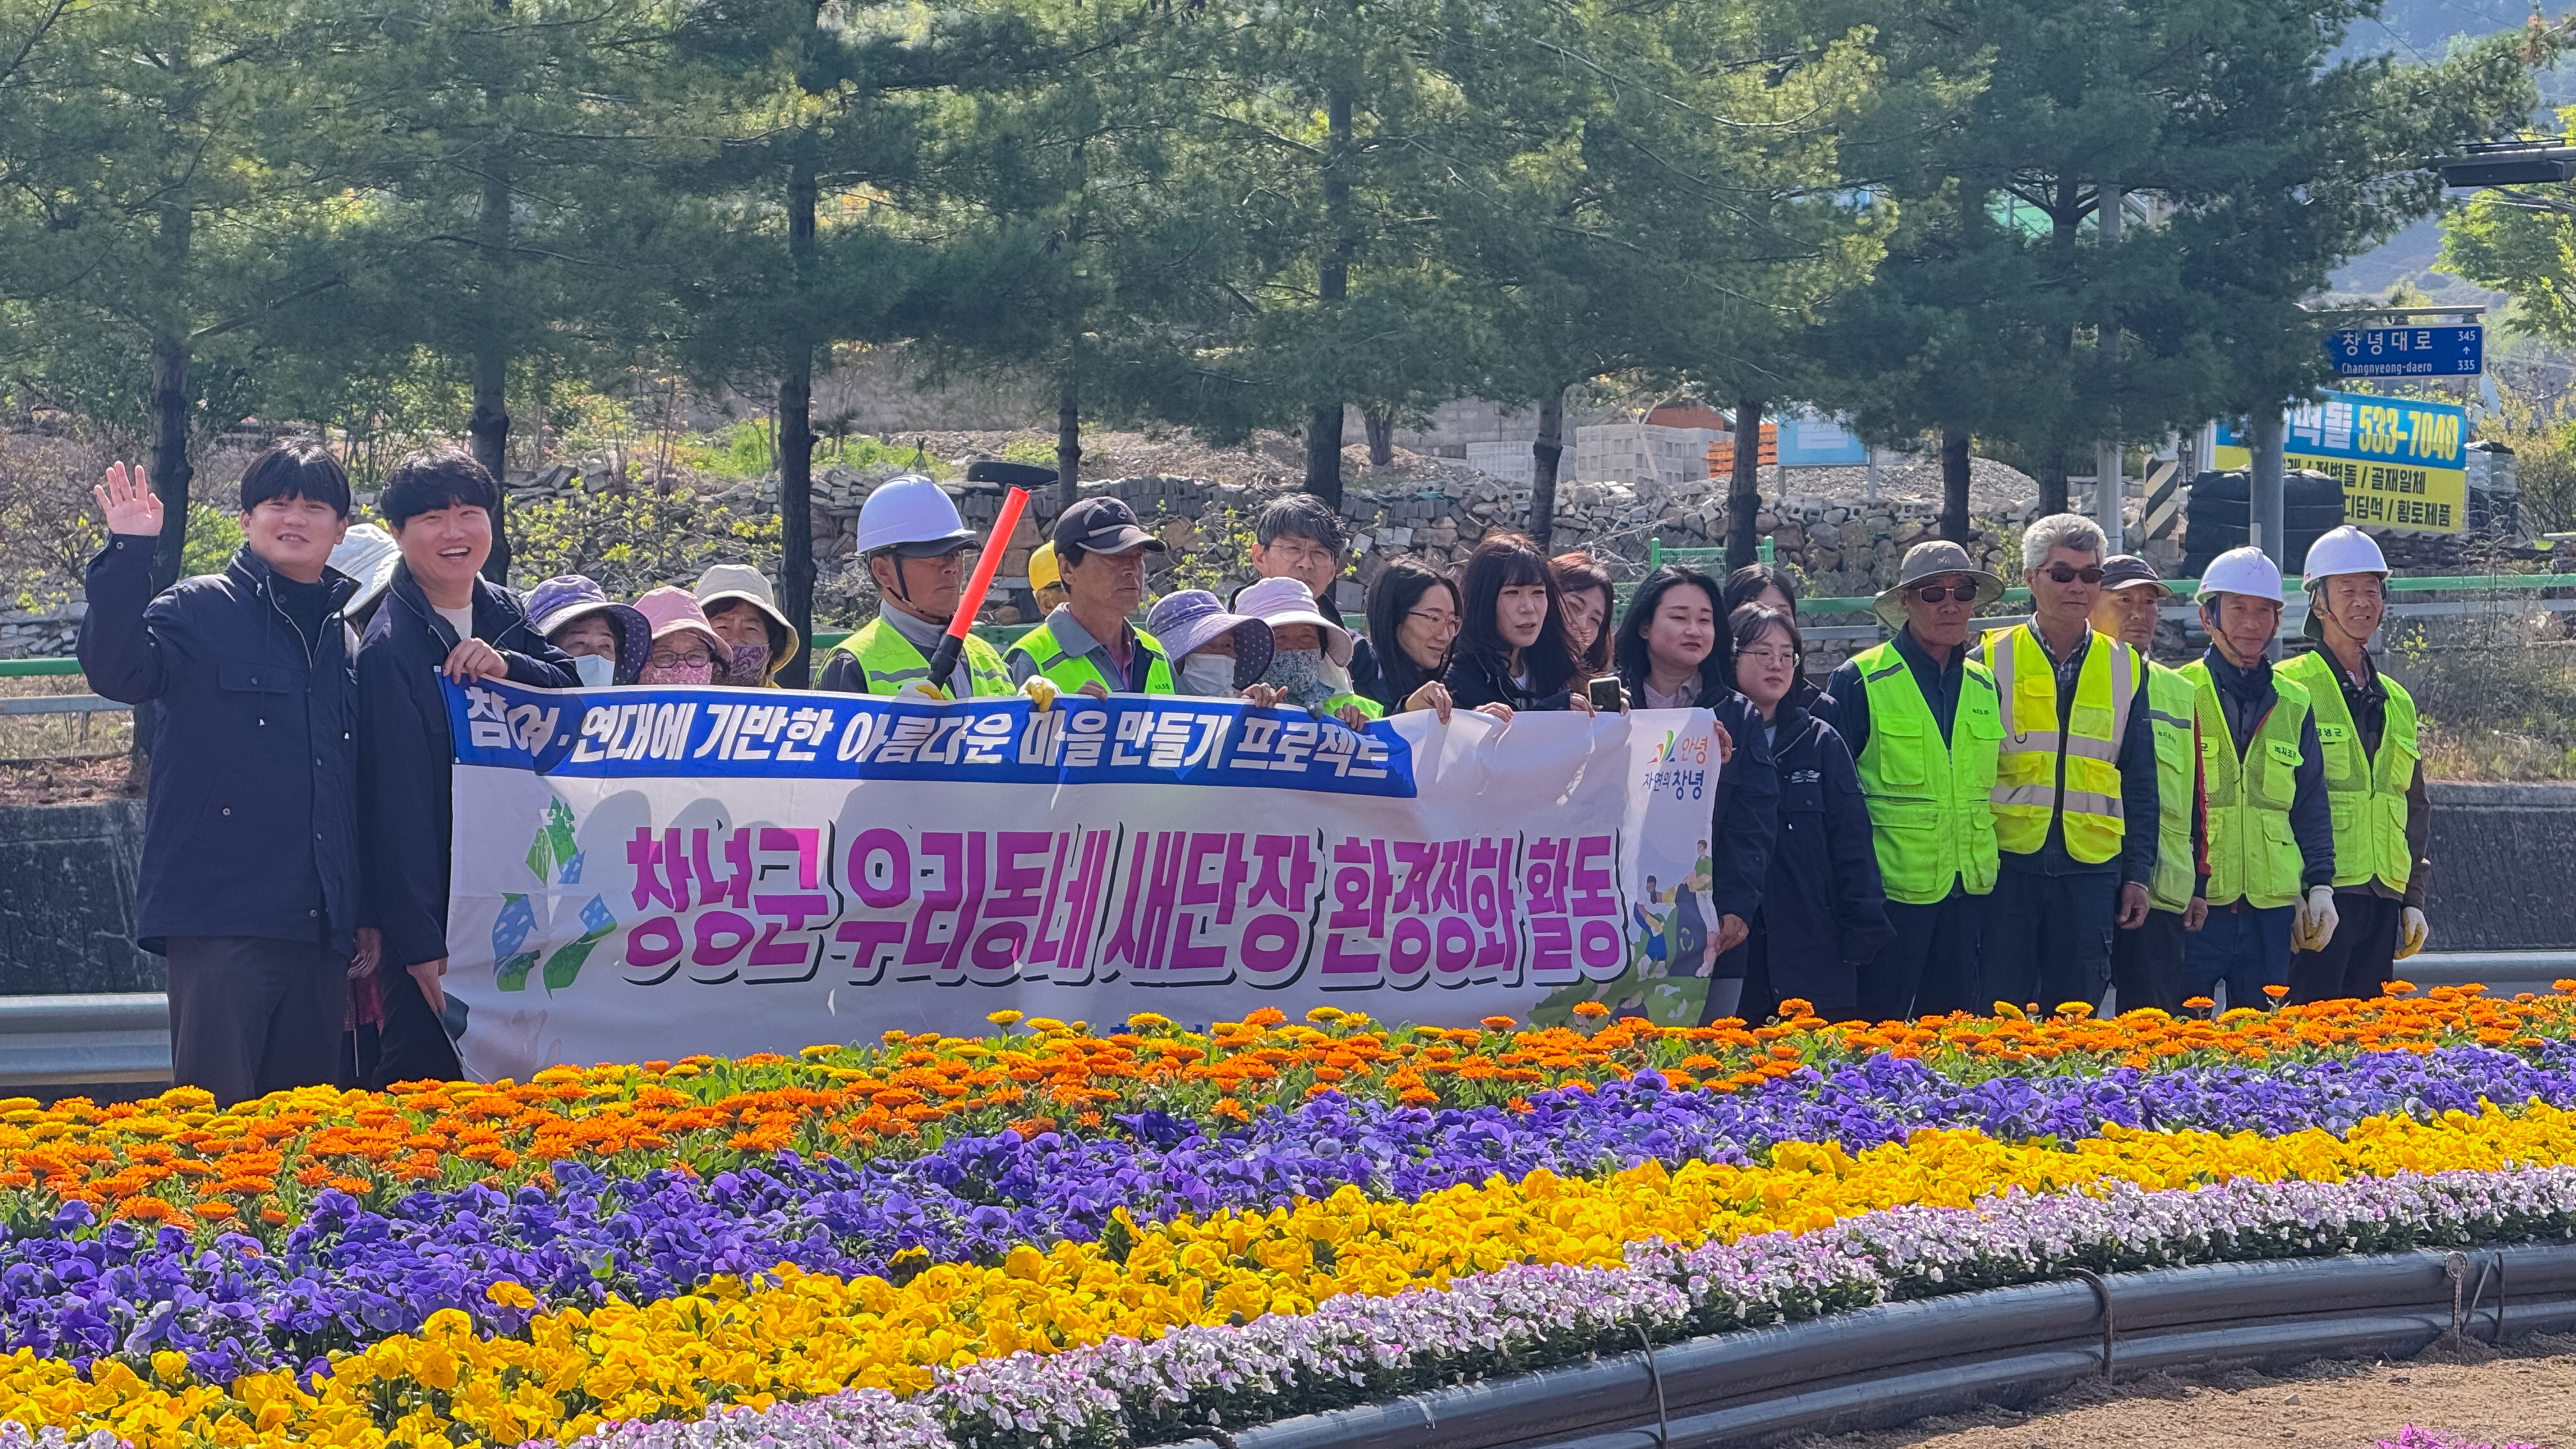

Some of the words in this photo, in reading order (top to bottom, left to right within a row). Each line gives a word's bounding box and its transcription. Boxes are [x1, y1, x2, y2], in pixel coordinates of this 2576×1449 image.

[2343, 331, 2432, 356] 창녕대로
[2458, 330, 2476, 341] 345
[2342, 361, 2432, 375] Changnyeong-daero
[2458, 360, 2475, 371] 335
[2359, 405, 2458, 461] 533-7040
[2372, 466, 2426, 494] 골재일체
[2398, 500, 2451, 527] 황토제품
[693, 704, 834, 761] 기반한
[836, 712, 1013, 765] 아름다운
[1018, 710, 1107, 767] 마을
[1110, 711, 1232, 769] 만들기
[1229, 717, 1388, 779] 프로젝트
[1682, 736, 1708, 765] 안녕
[1643, 770, 1672, 792] 자연의
[1672, 769, 1705, 801] 창녕
[626, 827, 829, 967] 창녕군
[836, 829, 1110, 970] 우리동네
[1104, 832, 1316, 972] 새단장
[1322, 837, 1517, 974] 환경정화
[1527, 836, 1620, 970] 활동
